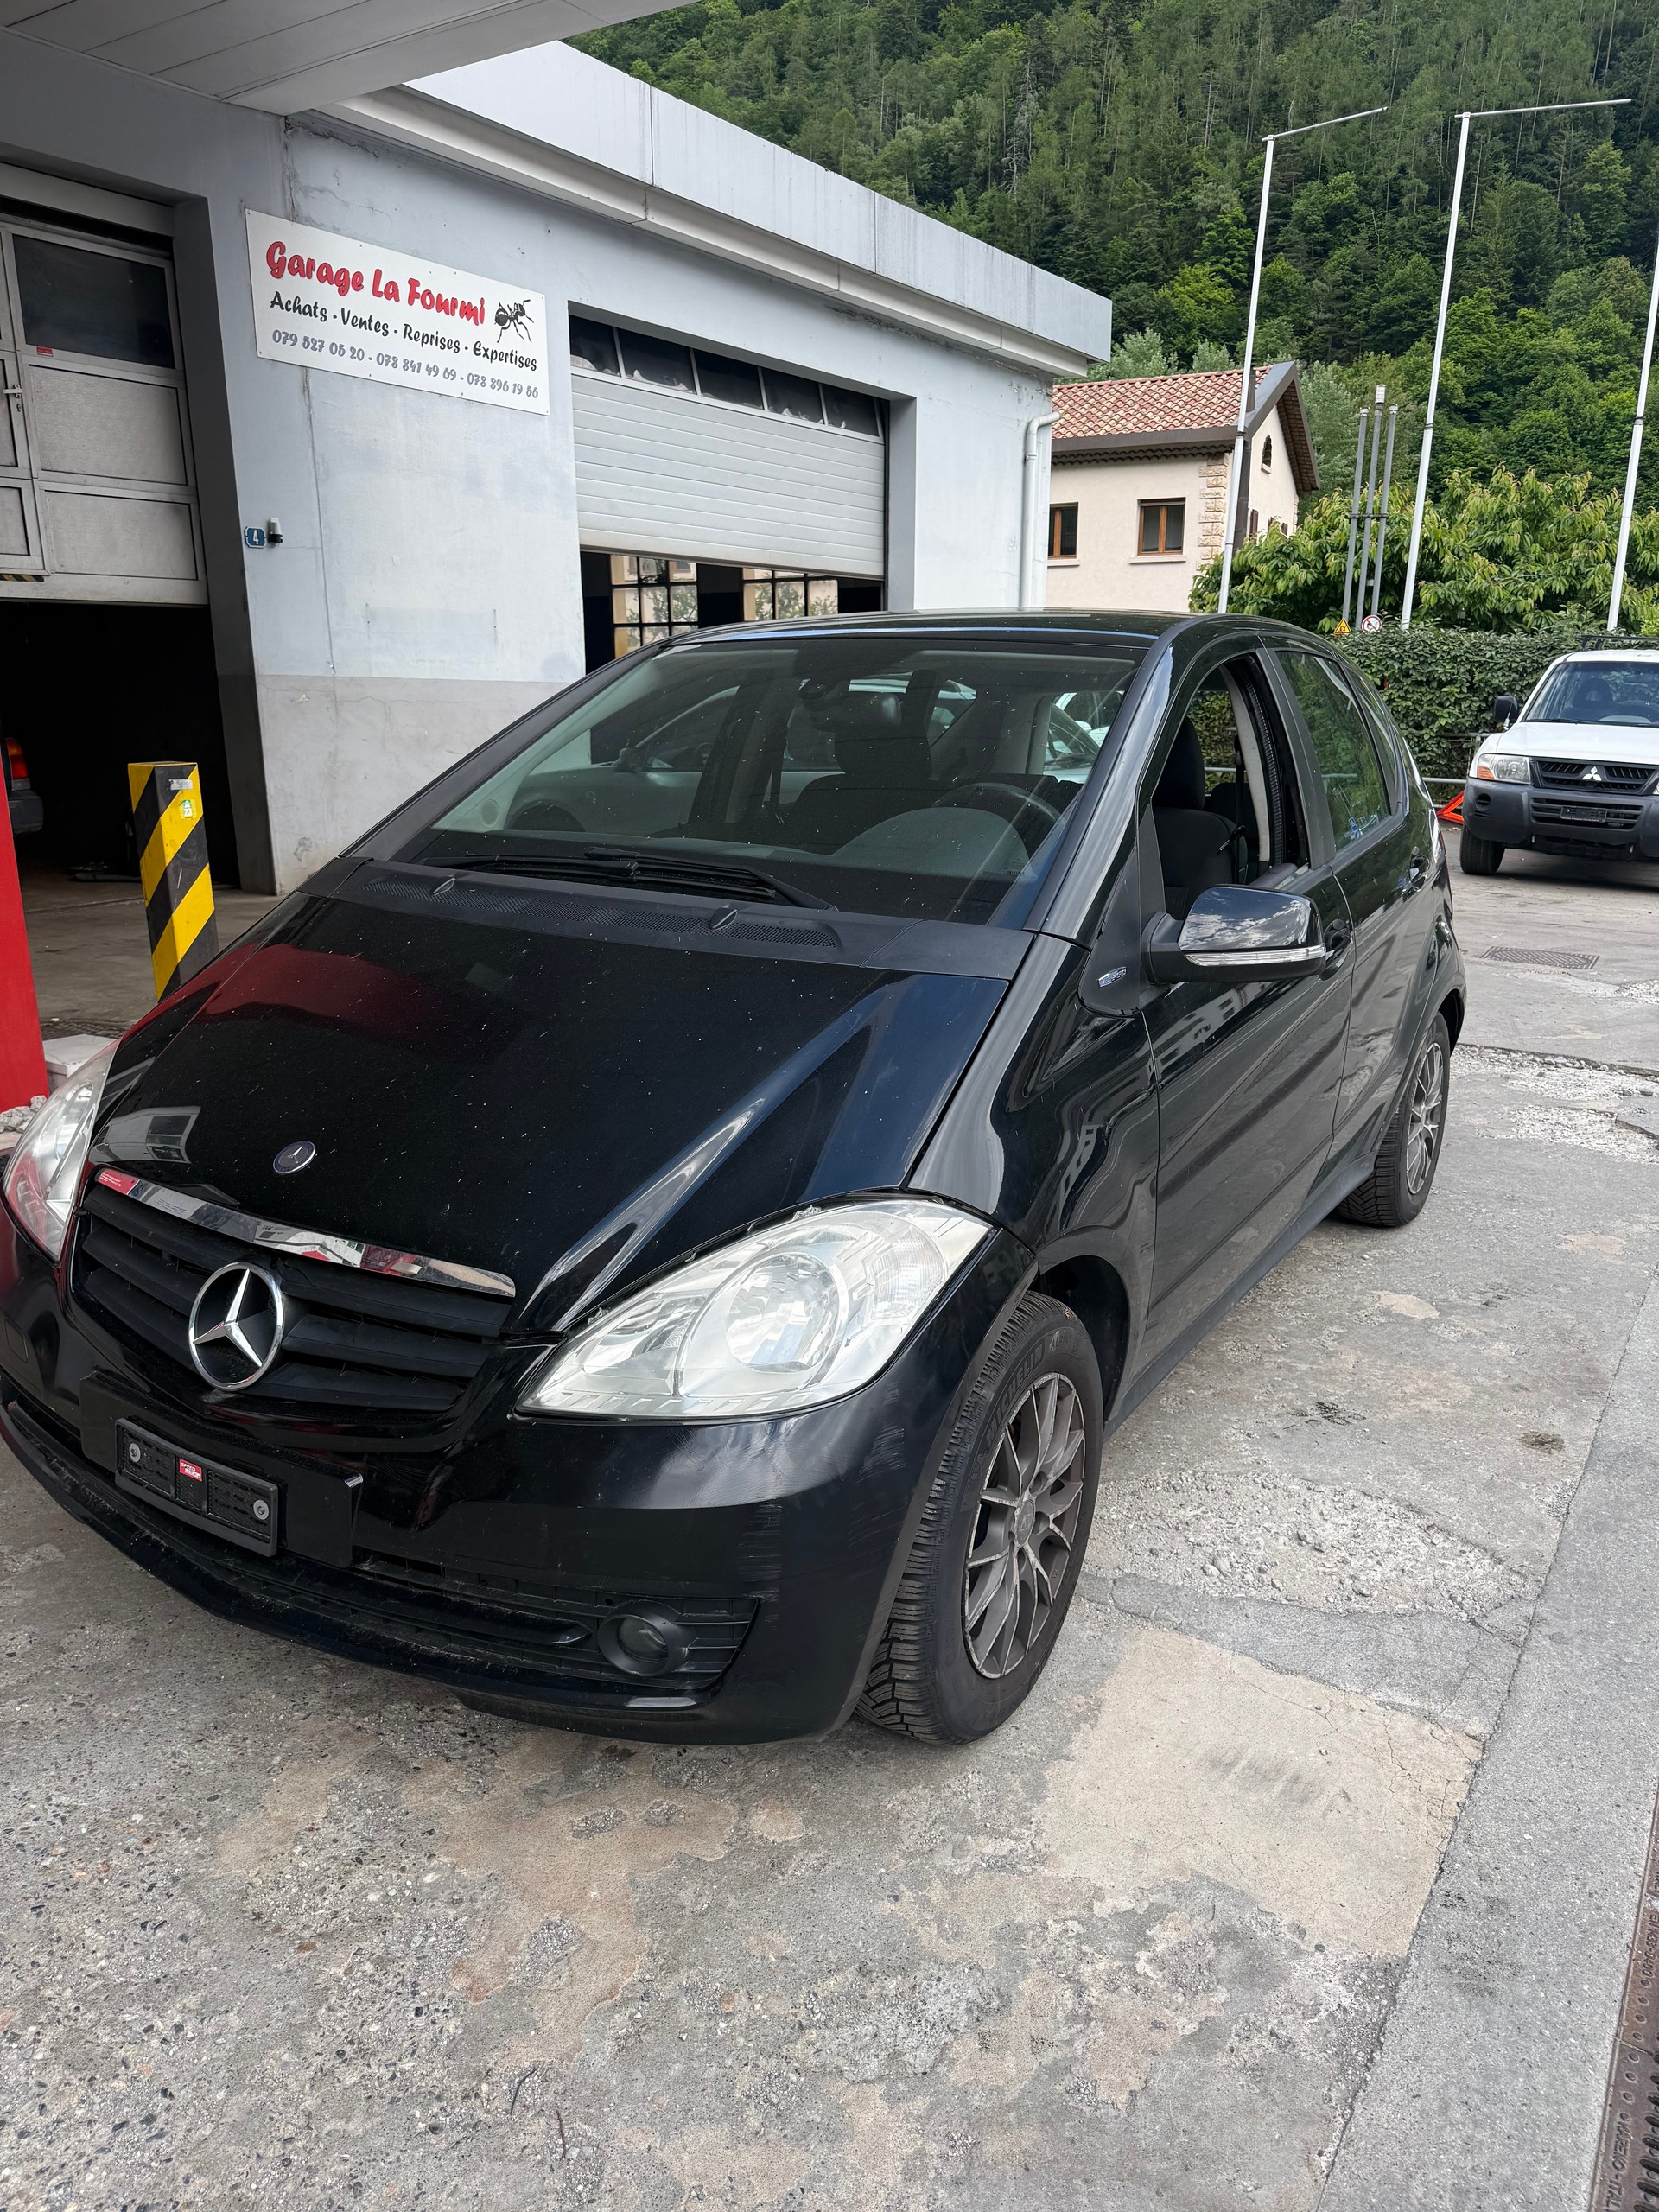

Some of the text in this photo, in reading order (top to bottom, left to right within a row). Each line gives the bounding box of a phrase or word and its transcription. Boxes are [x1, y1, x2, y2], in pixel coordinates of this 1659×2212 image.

[266, 241, 485, 326] Garage La Fourmi
[270, 291, 327, 322] Achats
[340, 308, 389, 337] Ventes
[403, 323, 461, 353] Reprises
[473, 340, 537, 372] Expertises
[272, 329, 298, 346] 079
[302, 335, 325, 353] 527
[329, 341, 346, 357] 05
[349, 346, 365, 361] 20
[376, 353, 398, 369] 078
[403, 358, 422, 374] 841
[425, 364, 440, 378] 49
[442, 367, 457, 381] 69
[467, 372, 486, 388] 078
[490, 378, 509, 392] 896
[512, 383, 524, 395] 19
[253, 530, 259, 545] 4
[986, 1342, 1044, 1447] MICHELIN
[1605, 2179, 1622, 2212] ITAL
